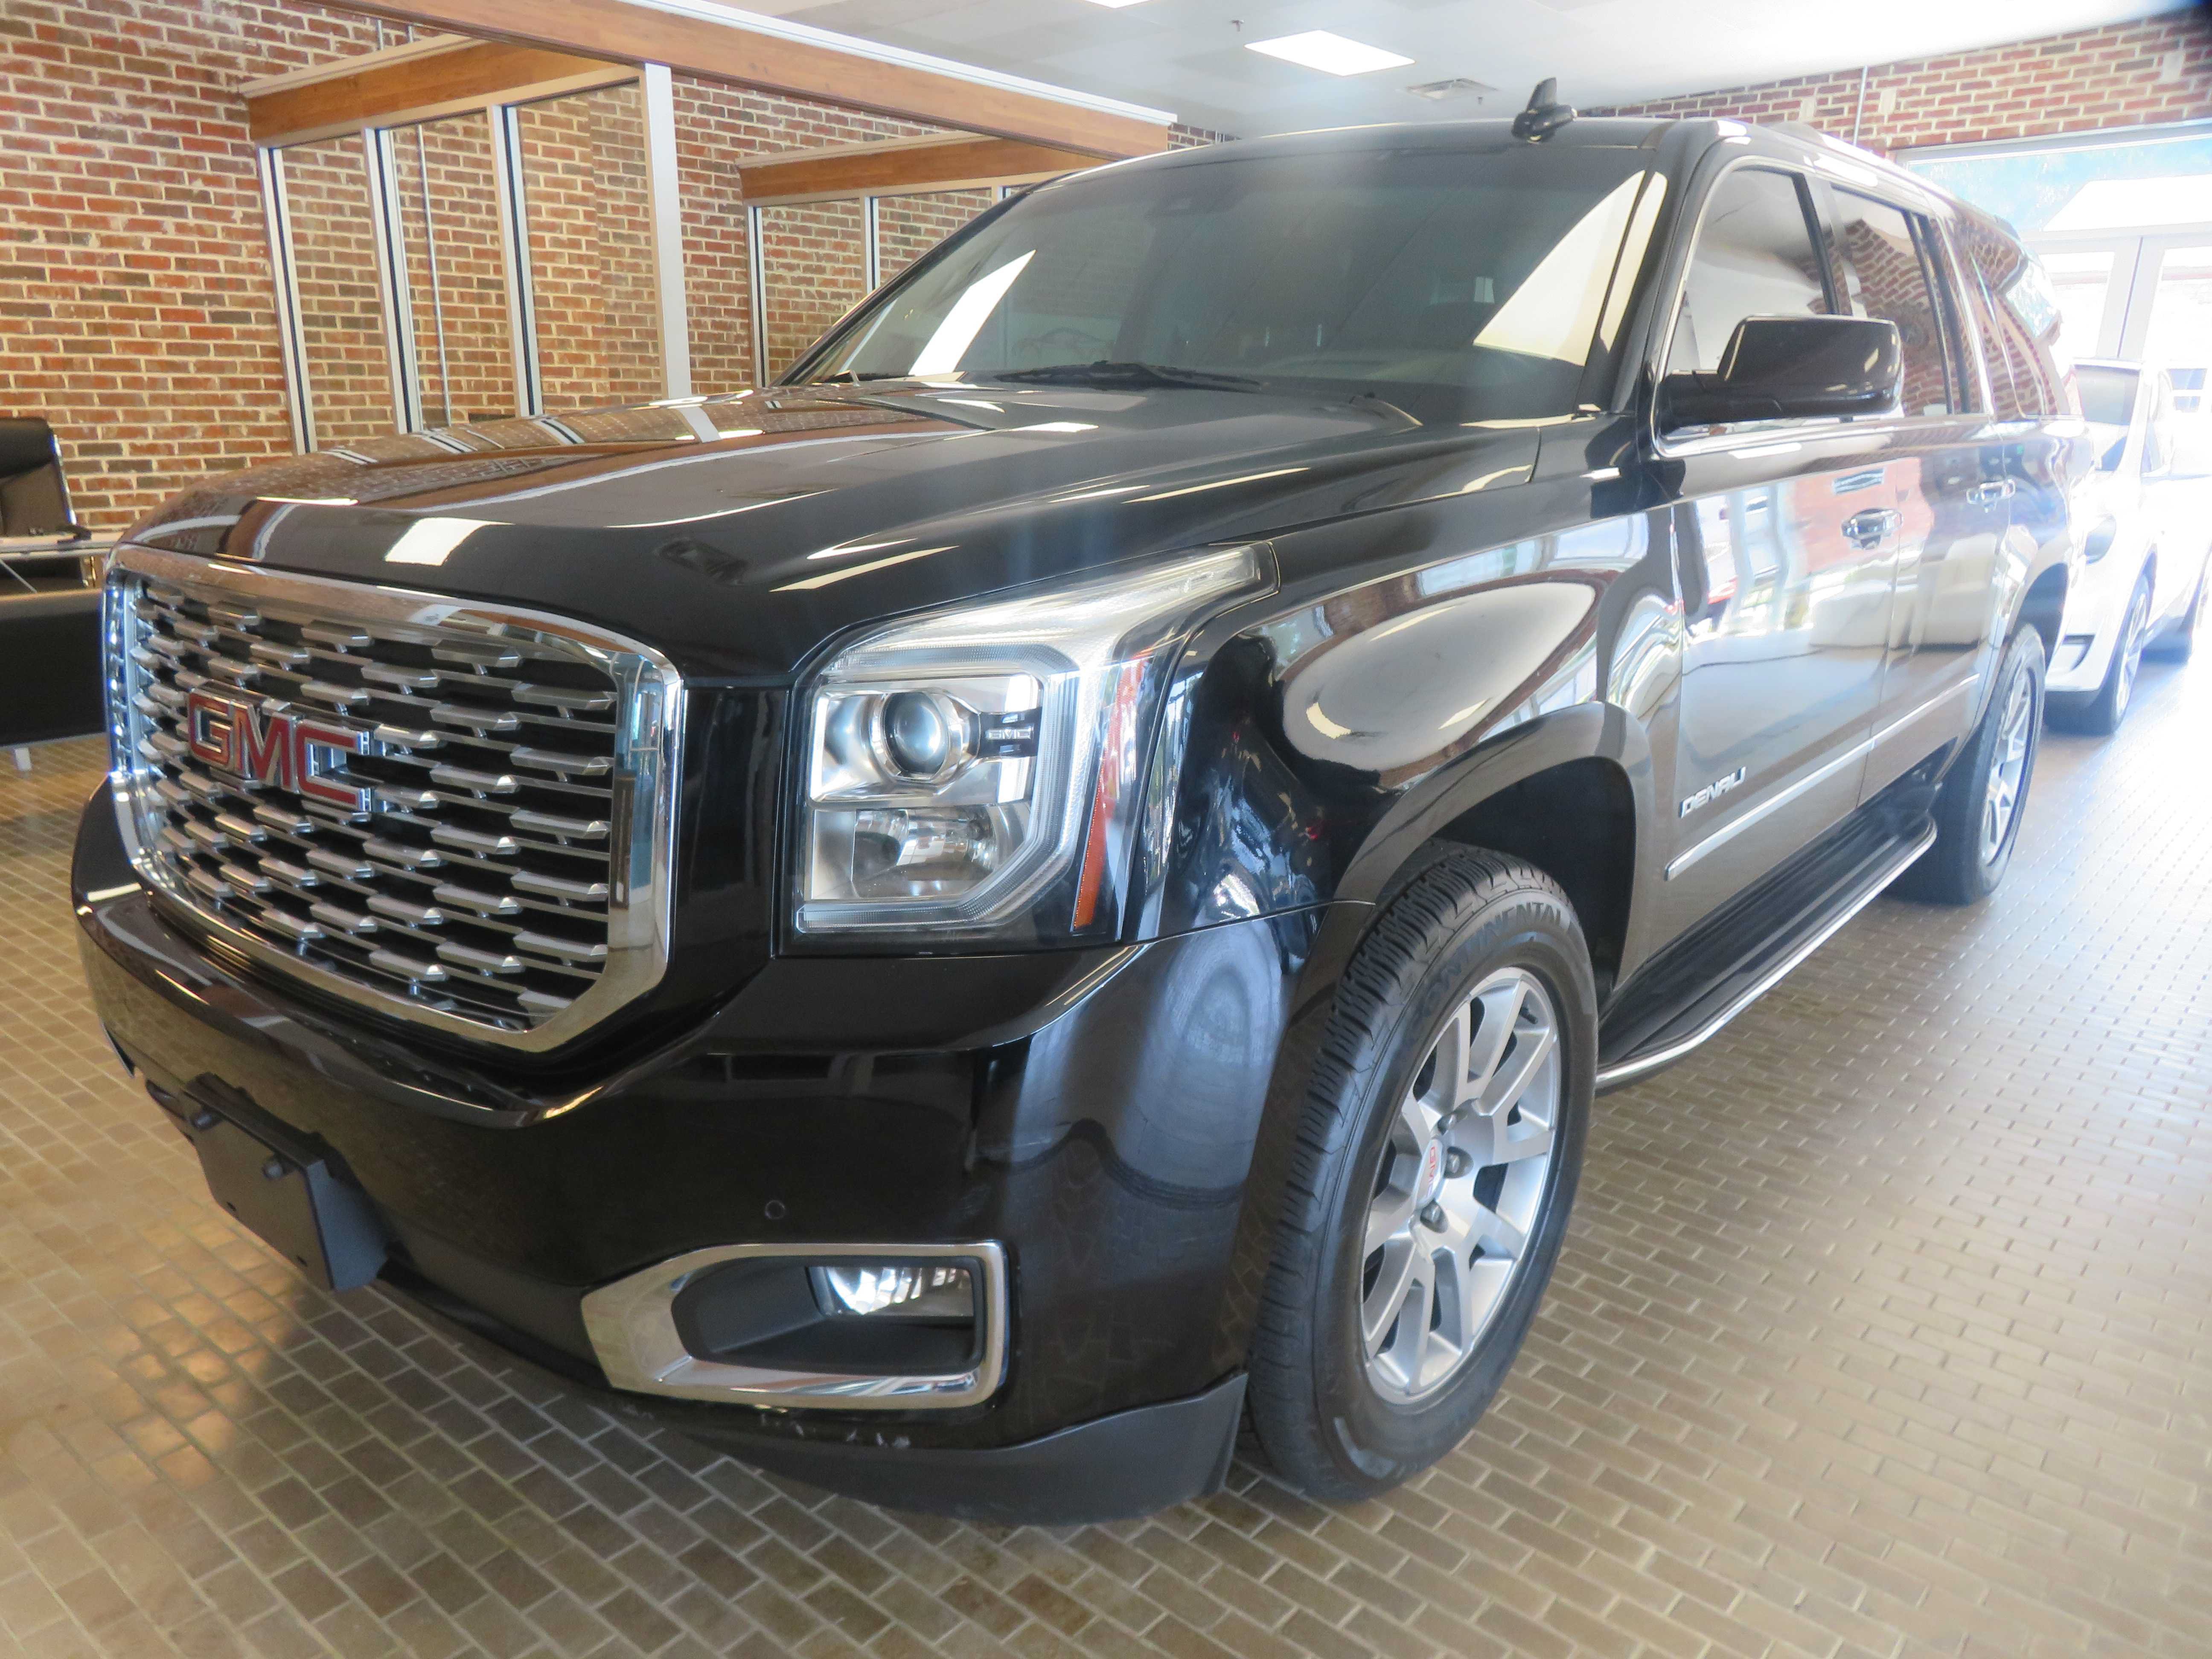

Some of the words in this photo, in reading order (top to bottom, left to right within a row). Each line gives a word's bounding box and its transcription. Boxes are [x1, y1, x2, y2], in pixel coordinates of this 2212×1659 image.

[188, 689, 371, 811] GMC
[985, 726, 1032, 739] GMC
[1678, 766, 1746, 818] DENALI
[1413, 901, 1562, 1022] ONTINENTAL
